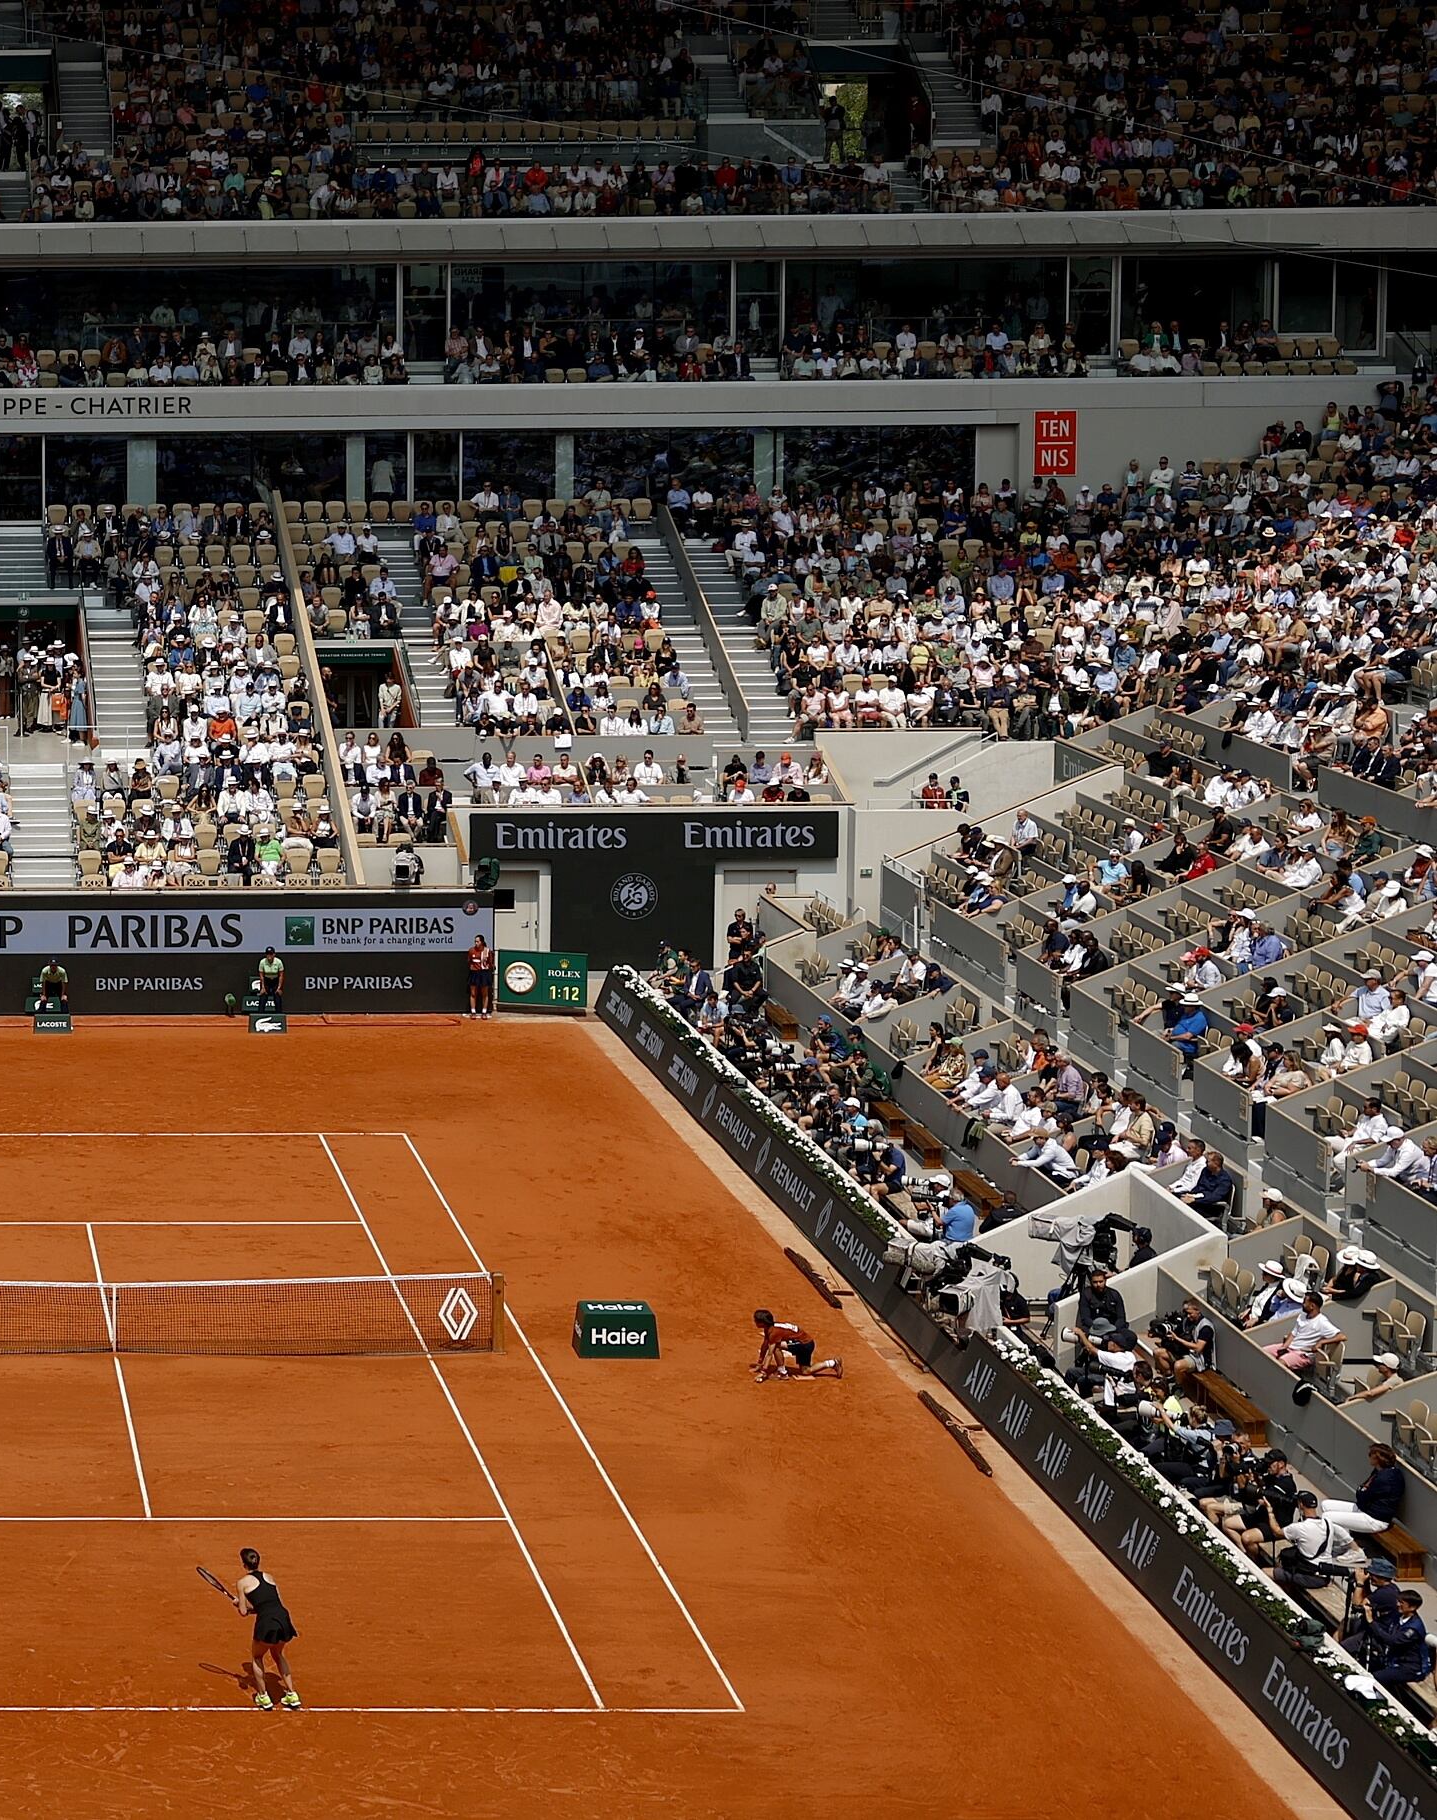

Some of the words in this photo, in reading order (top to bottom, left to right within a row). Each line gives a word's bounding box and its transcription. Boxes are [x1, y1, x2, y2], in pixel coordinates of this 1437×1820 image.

[70, 397, 192, 415] CHATRIER
[1040, 419, 1069, 437] TEN
[1041, 449, 1069, 467] NIS
[495, 821, 627, 849] Emirates
[683, 820, 816, 848] Emirates
[67, 913, 244, 949] PARIBAS
[322, 918, 364, 935] BNP
[369, 917, 455, 934] PARIBAS
[364, 937, 377, 945] for
[387, 936, 426, 946] changing
[428, 936, 453, 944] world
[305, 976, 339, 990] BNP
[343, 976, 413, 990] PARIBAS
[548, 970, 581, 978] ROLEX
[96, 977, 130, 991] BNP
[133, 977, 204, 991] PARIBAS
[549, 985, 579, 1001] 1:12
[715, 1101, 756, 1152] RENAULT
[769, 1157, 816, 1212] RENAULT
[832, 1220, 885, 1283] RENAULT
[591, 1327, 648, 1345] Haier
[1172, 1564, 1250, 1666] Emirates
[1262, 1655, 1350, 1770] Emirates
